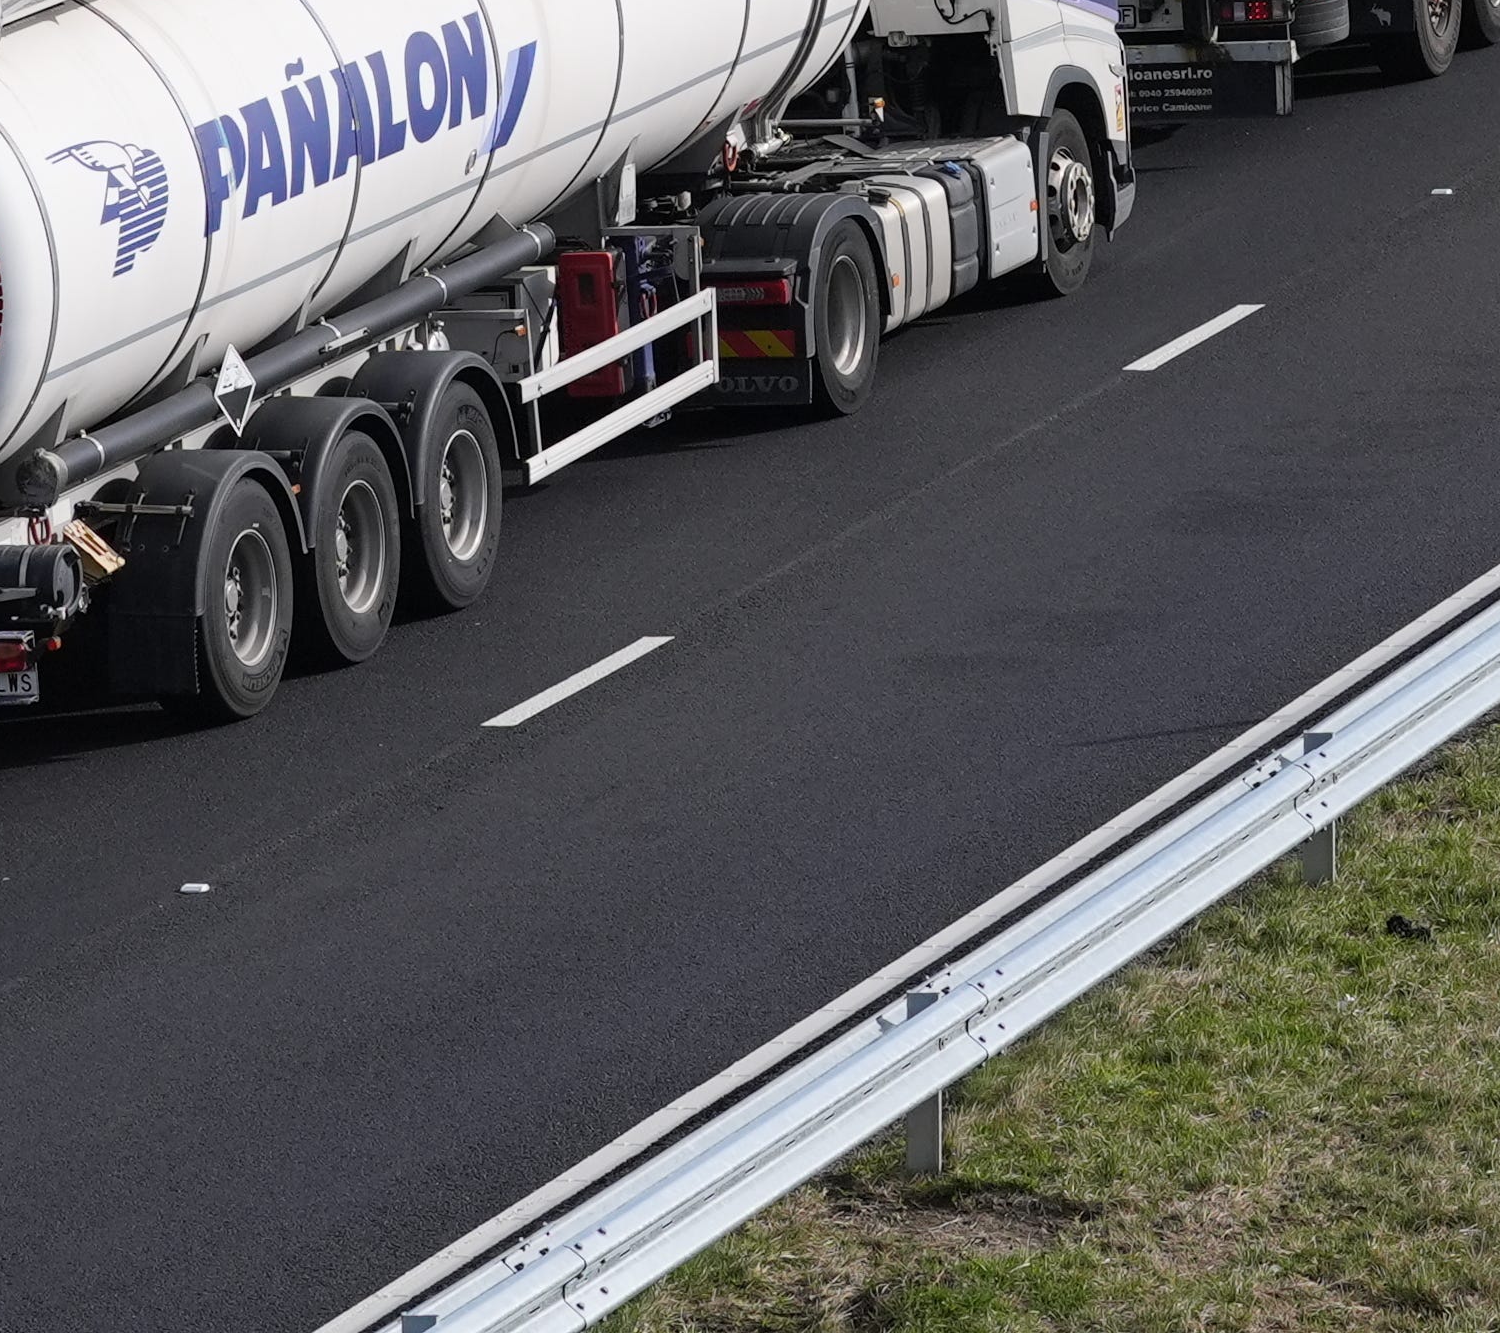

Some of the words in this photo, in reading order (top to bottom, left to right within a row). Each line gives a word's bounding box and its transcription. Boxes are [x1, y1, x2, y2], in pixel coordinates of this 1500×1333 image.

[1129, 66, 1213, 81] ioanesrl.ro
[194, 10, 488, 239] PAÑALON
[720, 376, 799, 393] OLVO
